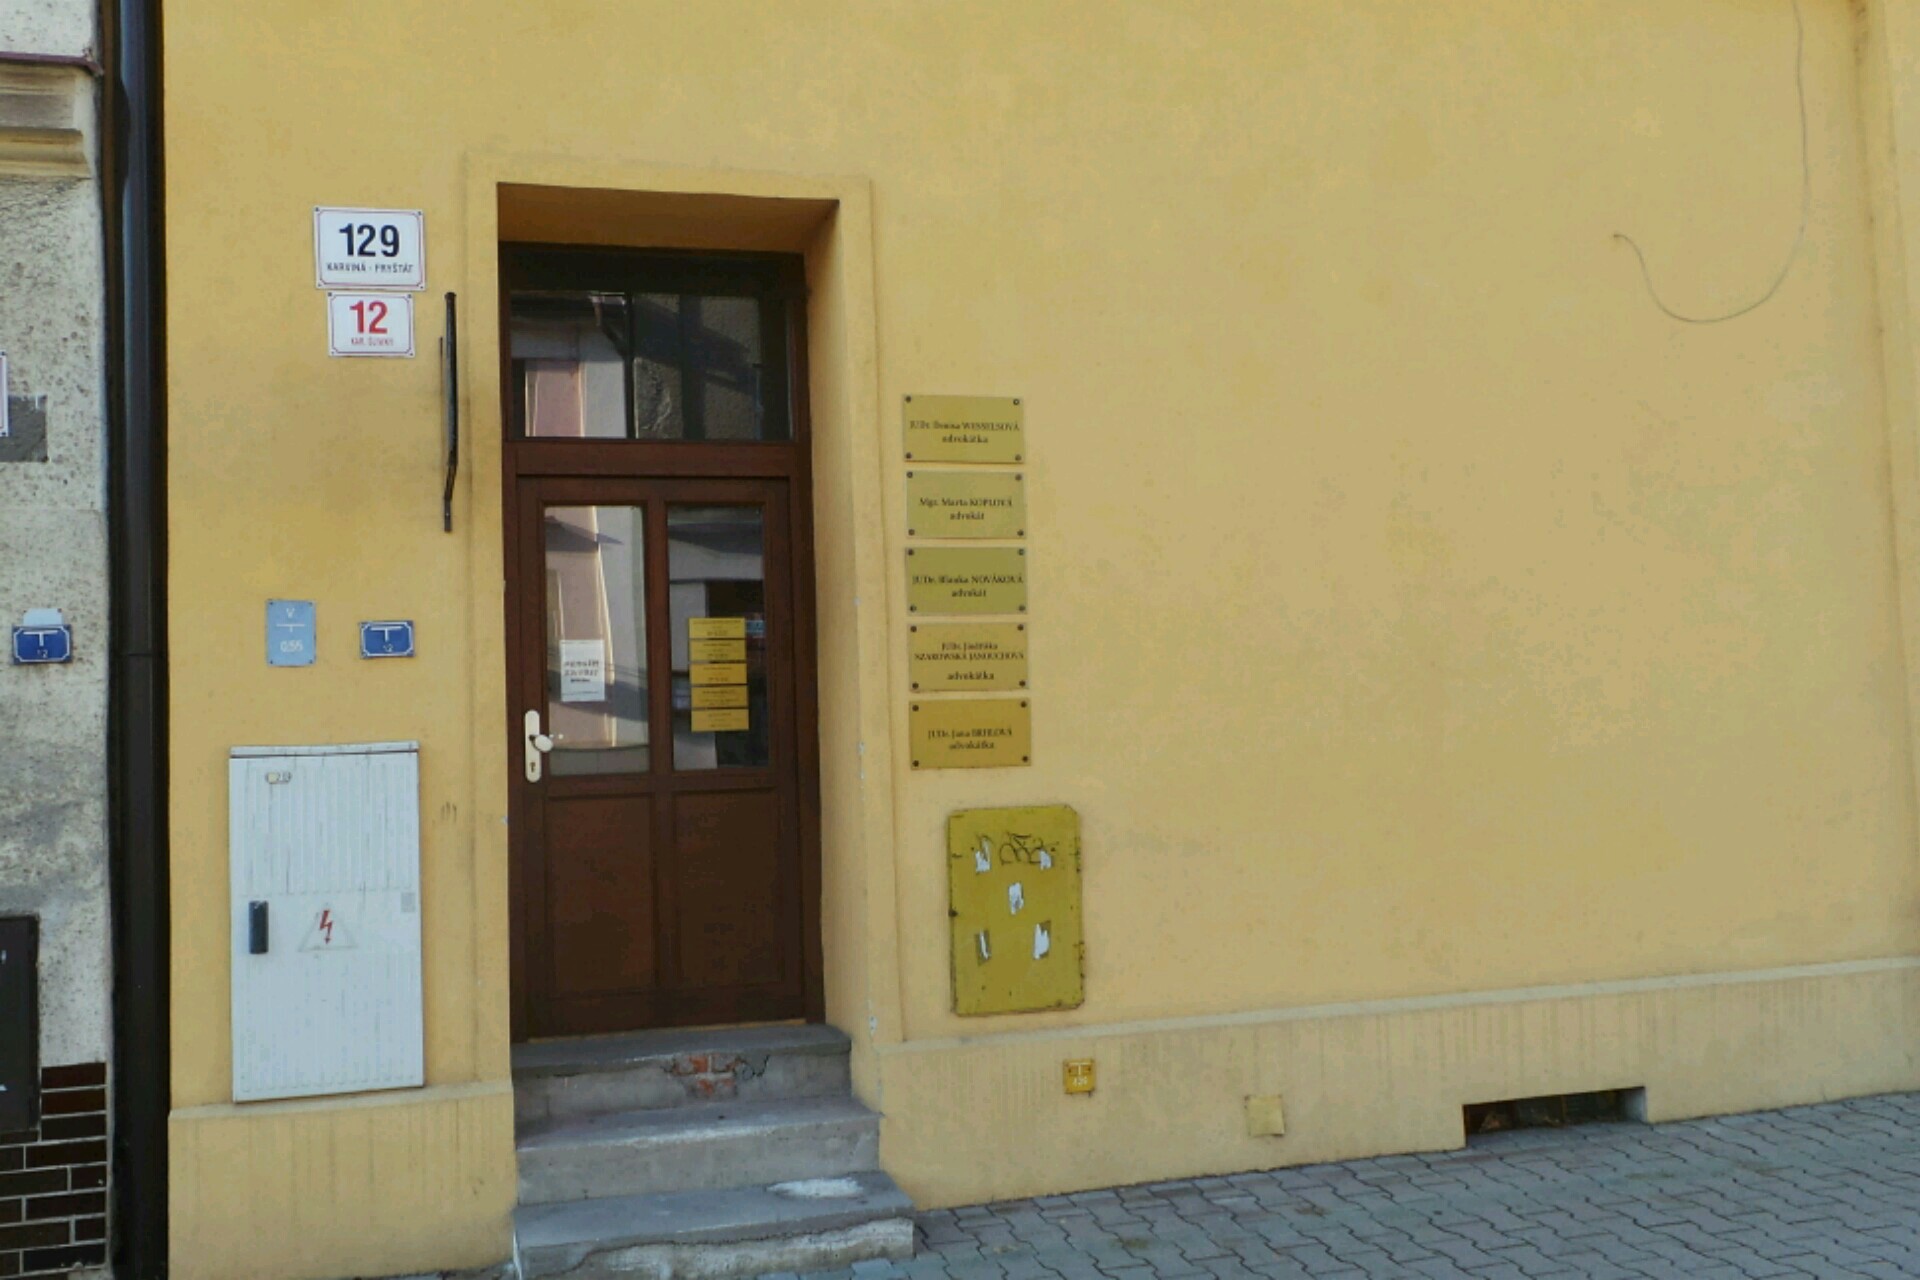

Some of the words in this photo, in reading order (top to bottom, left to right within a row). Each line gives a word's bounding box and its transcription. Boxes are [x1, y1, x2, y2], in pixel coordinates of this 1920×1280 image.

[339, 223, 399, 257] 129
[327, 261, 366, 272] KARVINÁ
[349, 300, 388, 334] 12
[942, 433, 988, 443] advokátka
[919, 497, 938, 508] Mgr.
[941, 497, 968, 506] Marta
[950, 512, 985, 520] advokát
[912, 575, 935, 585] JUDr.
[971, 572, 1023, 584] NOVÁKOVÁ
[951, 589, 987, 598] advokát
[947, 671, 995, 680] advokátka
[949, 740, 995, 749] advokátka
